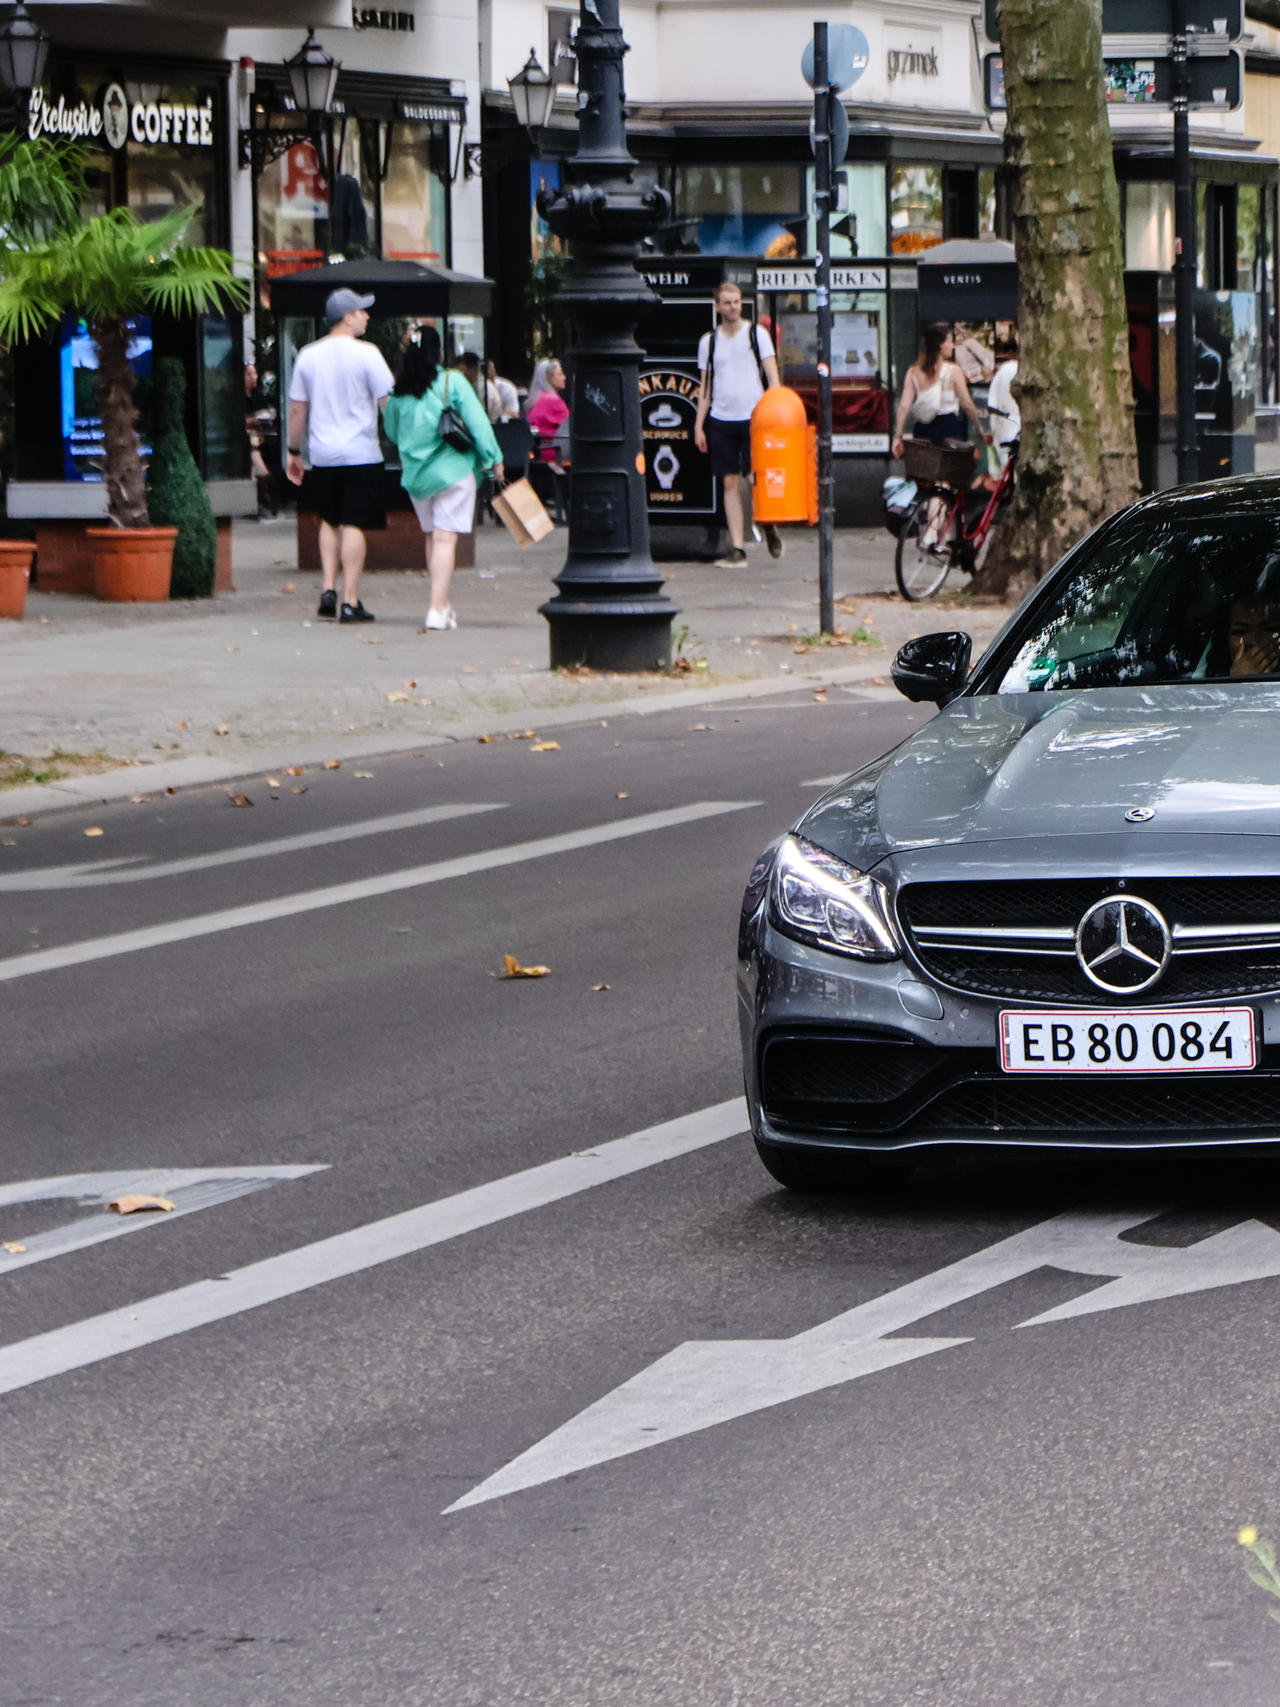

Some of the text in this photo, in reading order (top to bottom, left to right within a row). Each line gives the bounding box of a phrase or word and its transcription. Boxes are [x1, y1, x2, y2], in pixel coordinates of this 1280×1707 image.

[887, 44, 938, 81] grzimek
[28, 86, 212, 146] Exclusive COFFEE
[1023, 1021, 1232, 1062] EB 80 084
